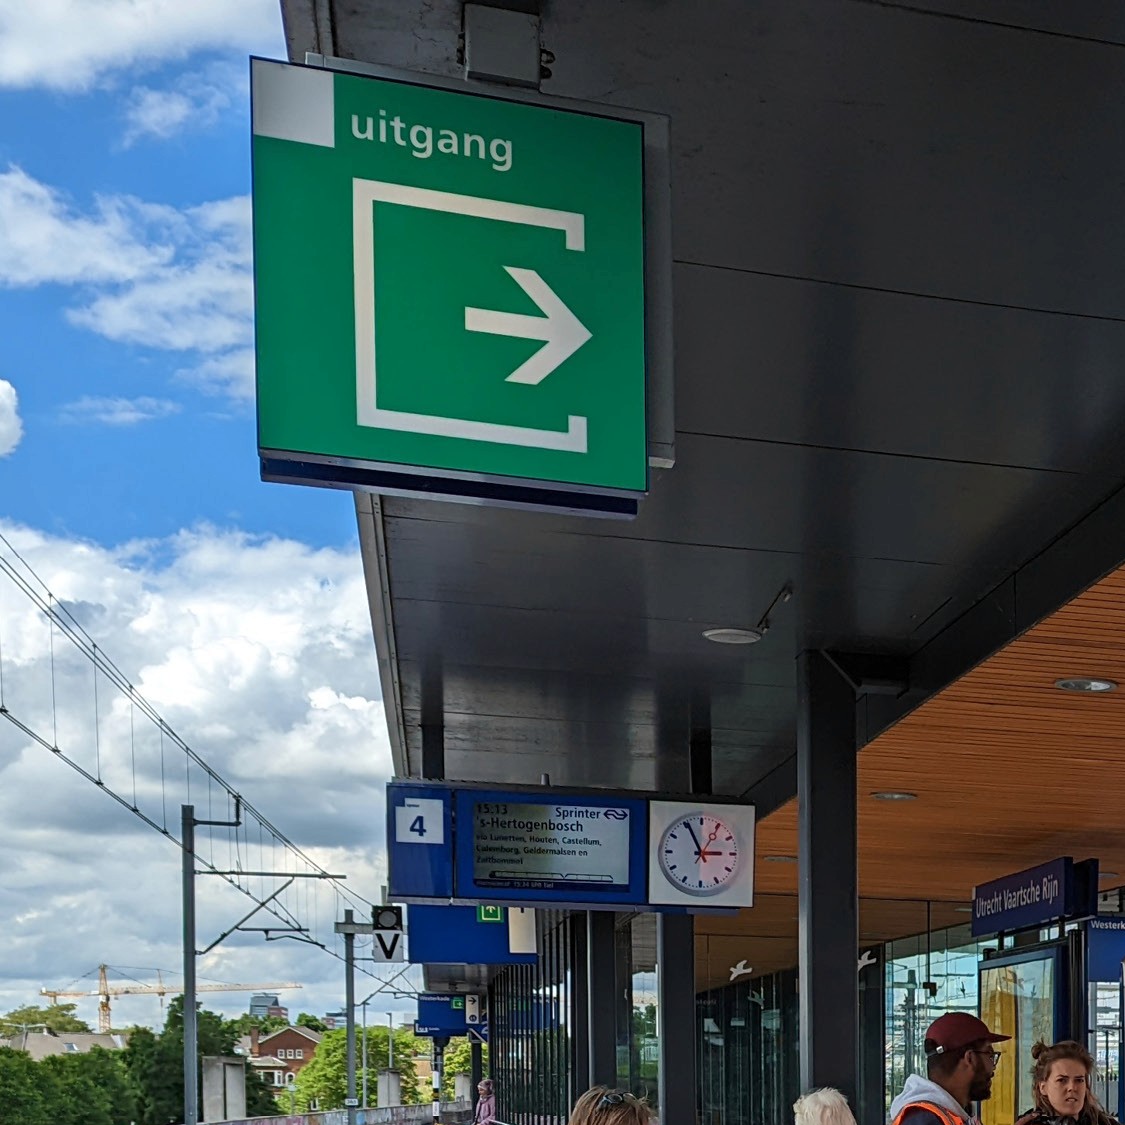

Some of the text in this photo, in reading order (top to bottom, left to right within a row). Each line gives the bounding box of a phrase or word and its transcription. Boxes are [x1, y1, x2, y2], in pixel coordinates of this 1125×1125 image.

[351, 109, 513, 172] uitgang
[555, 806, 601, 820] Sprinter
[409, 815, 427, 837] 4
[476, 815, 584, 833] 's-Hertogenbosch
[530, 835, 560, 845] Houten,
[562, 837, 602, 847] Castellum,
[523, 847, 577, 856] Geldermalsen
[976, 873, 1059, 919] Utrecht Vaartsche Rijn
[374, 932, 401, 960] V
